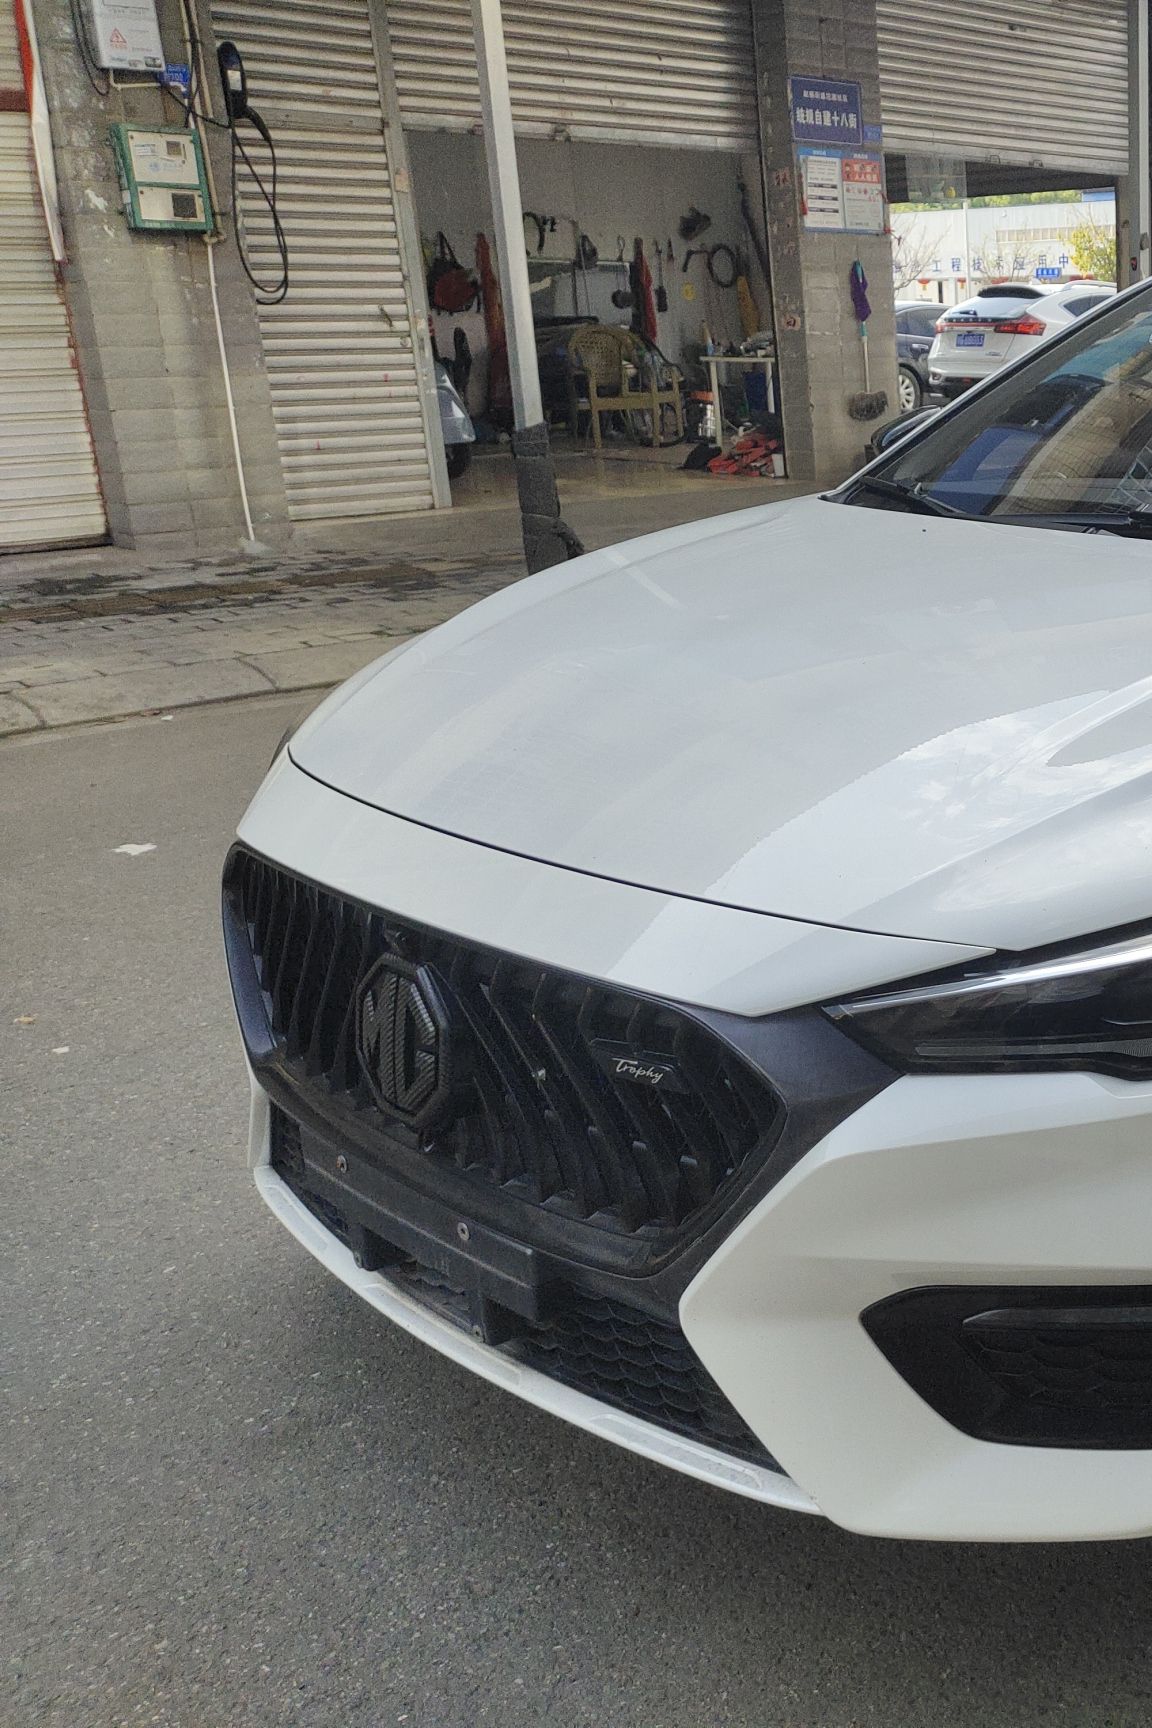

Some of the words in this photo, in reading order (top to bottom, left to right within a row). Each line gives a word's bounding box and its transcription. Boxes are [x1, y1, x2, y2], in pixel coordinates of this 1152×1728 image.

[796, 106, 857, 129] 统规自建十八街
[363, 971, 436, 1111] MG
[611, 1057, 664, 1084] Trophy
